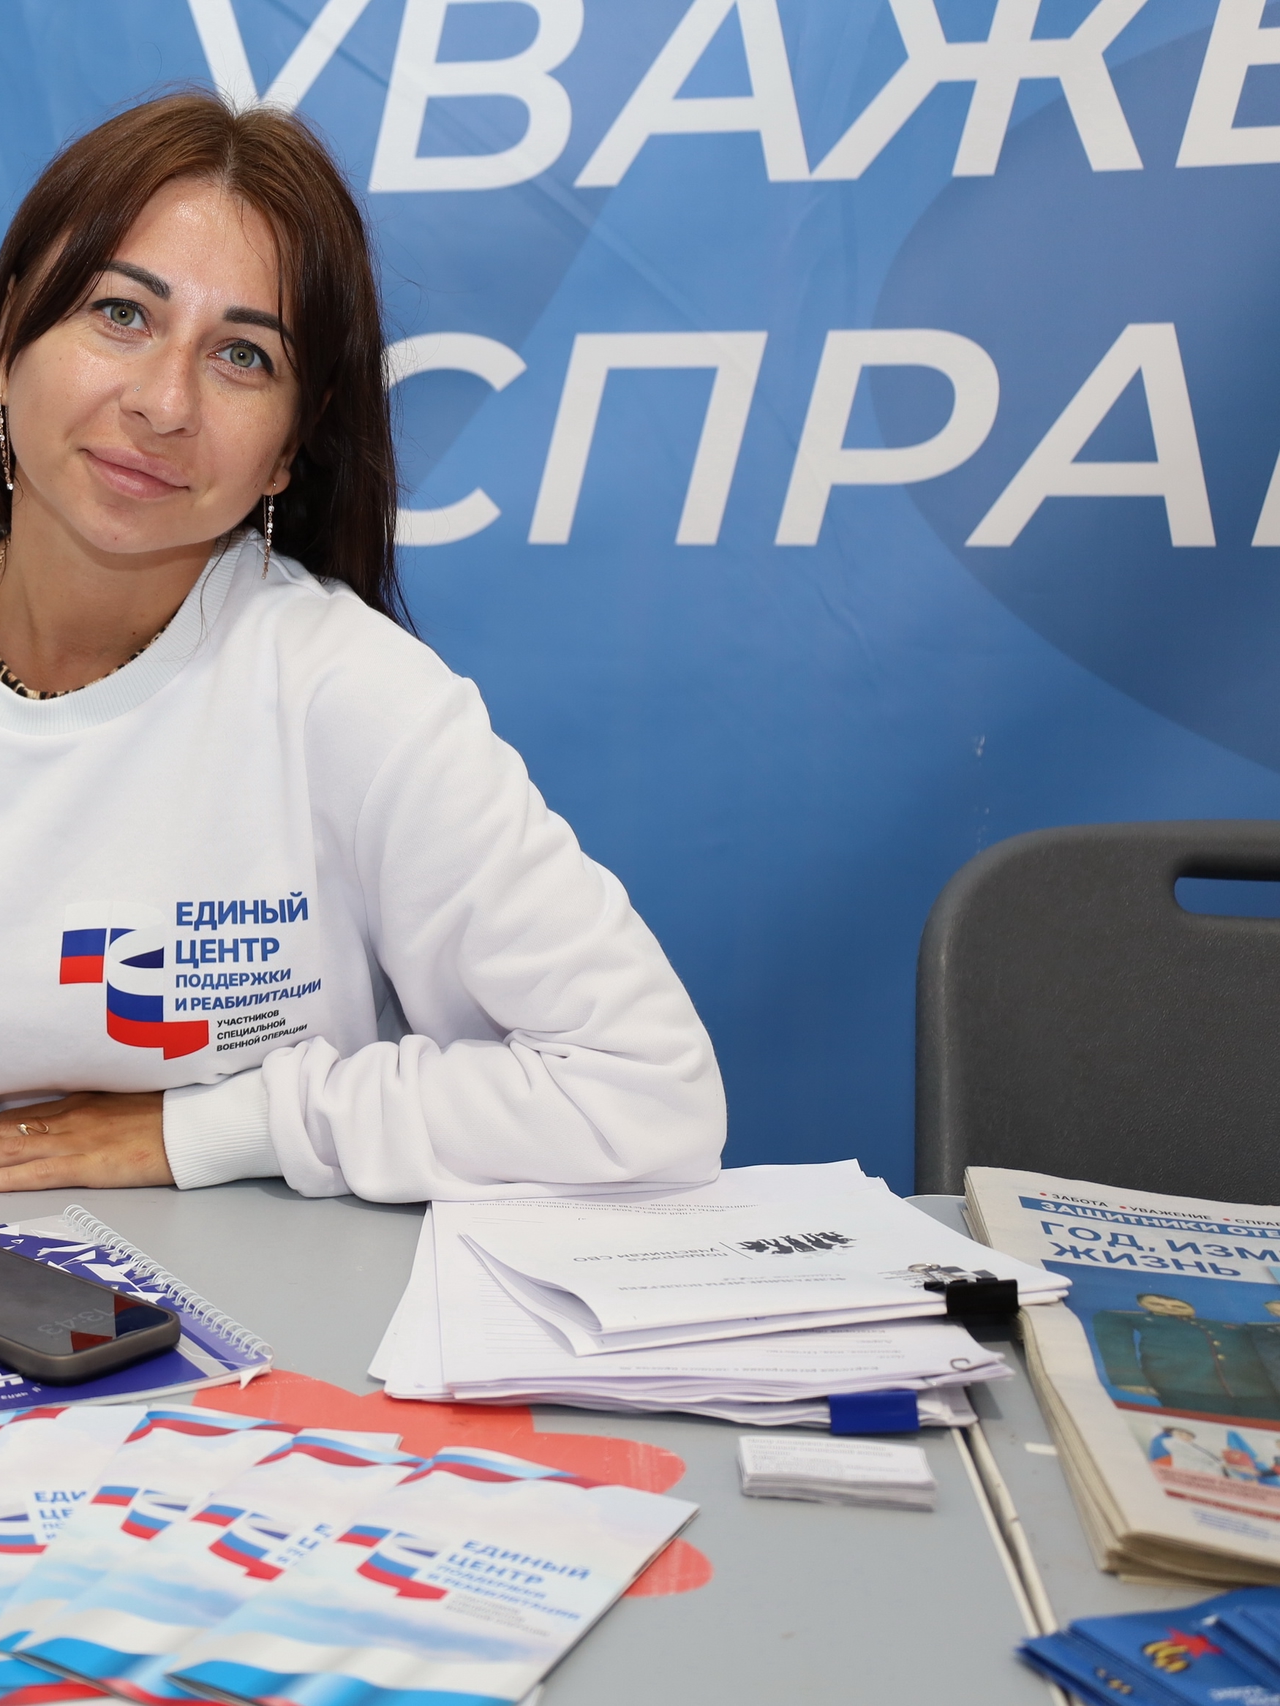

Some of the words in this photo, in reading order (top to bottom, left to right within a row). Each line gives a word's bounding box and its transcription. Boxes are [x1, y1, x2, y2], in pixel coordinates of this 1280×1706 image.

[386, 323, 1280, 549] СПРА
[176, 891, 308, 931] ЕДИНЫЙ
[175, 937, 280, 969] ЦЕНТР
[175, 968, 291, 990] ПОДДЕРЖКИ
[175, 997, 187, 1012] И
[191, 978, 322, 1011] РЕАБИЛИТАЦИИ
[217, 1009, 279, 1027] УЧАСТНИКОВ
[217, 1018, 286, 1040] СПЕЦИАЛЬНОЙ
[216, 1036, 260, 1052] ВОЕННОЙ
[261, 1024, 308, 1043] ОПЕРАЦИИ
[1052, 1194, 1109, 1207] ЗАБОТА
[1130, 1206, 1211, 1221] УВАЖЕНИЕ
[1041, 1202, 1220, 1233] ЗАЩИТНИКИ
[1040, 1221, 1156, 1252] ГОД,
[1048, 1242, 1241, 1276] ЖИЗНЬ
[37, 1308, 114, 1335] 13:43
[447, 1553, 545, 1585] ЦЕНТР
[462, 1539, 591, 1580] ЕДИНЫЙ
